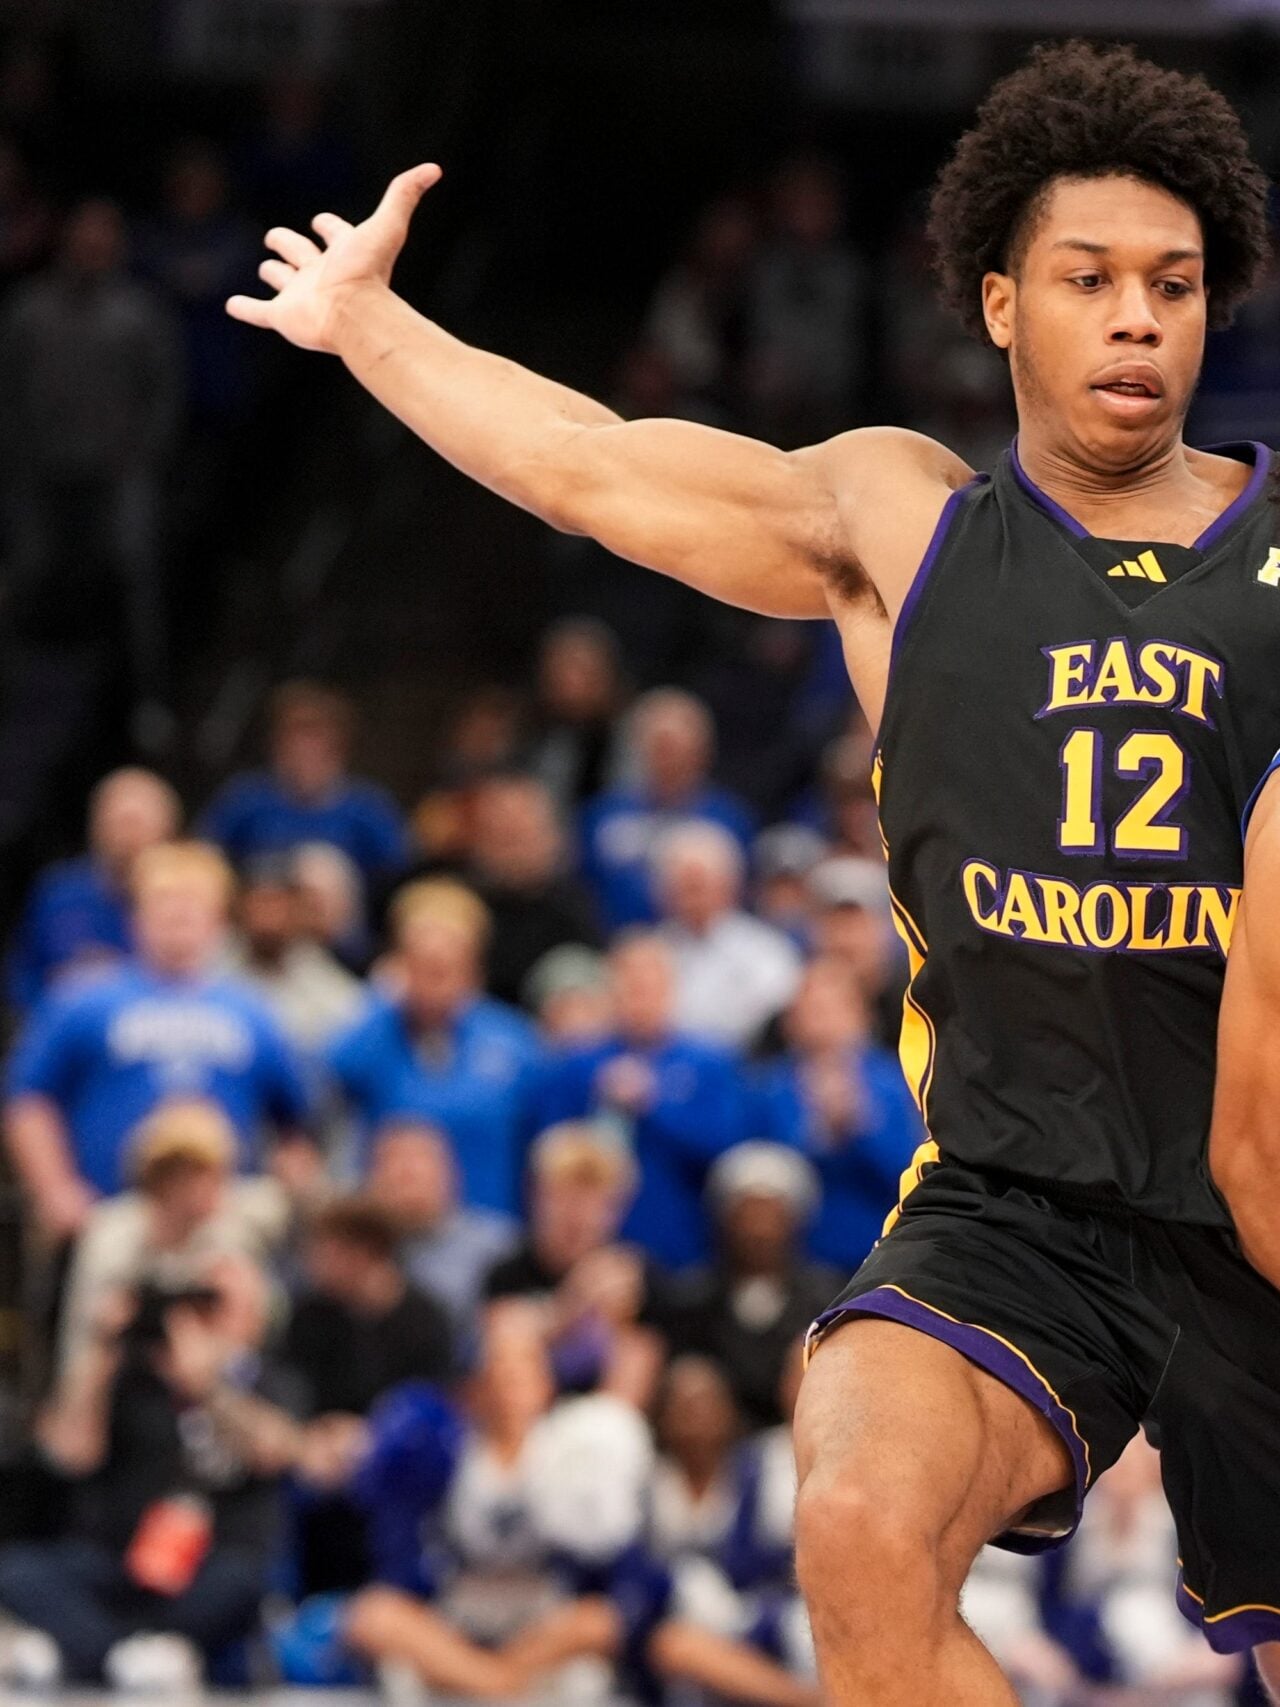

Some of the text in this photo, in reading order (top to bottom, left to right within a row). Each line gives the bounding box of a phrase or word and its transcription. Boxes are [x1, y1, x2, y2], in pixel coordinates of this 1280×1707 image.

[1034, 637, 1224, 728] EAST
[1058, 728, 1188, 857] 12
[961, 857, 1244, 957] CAROLIN
